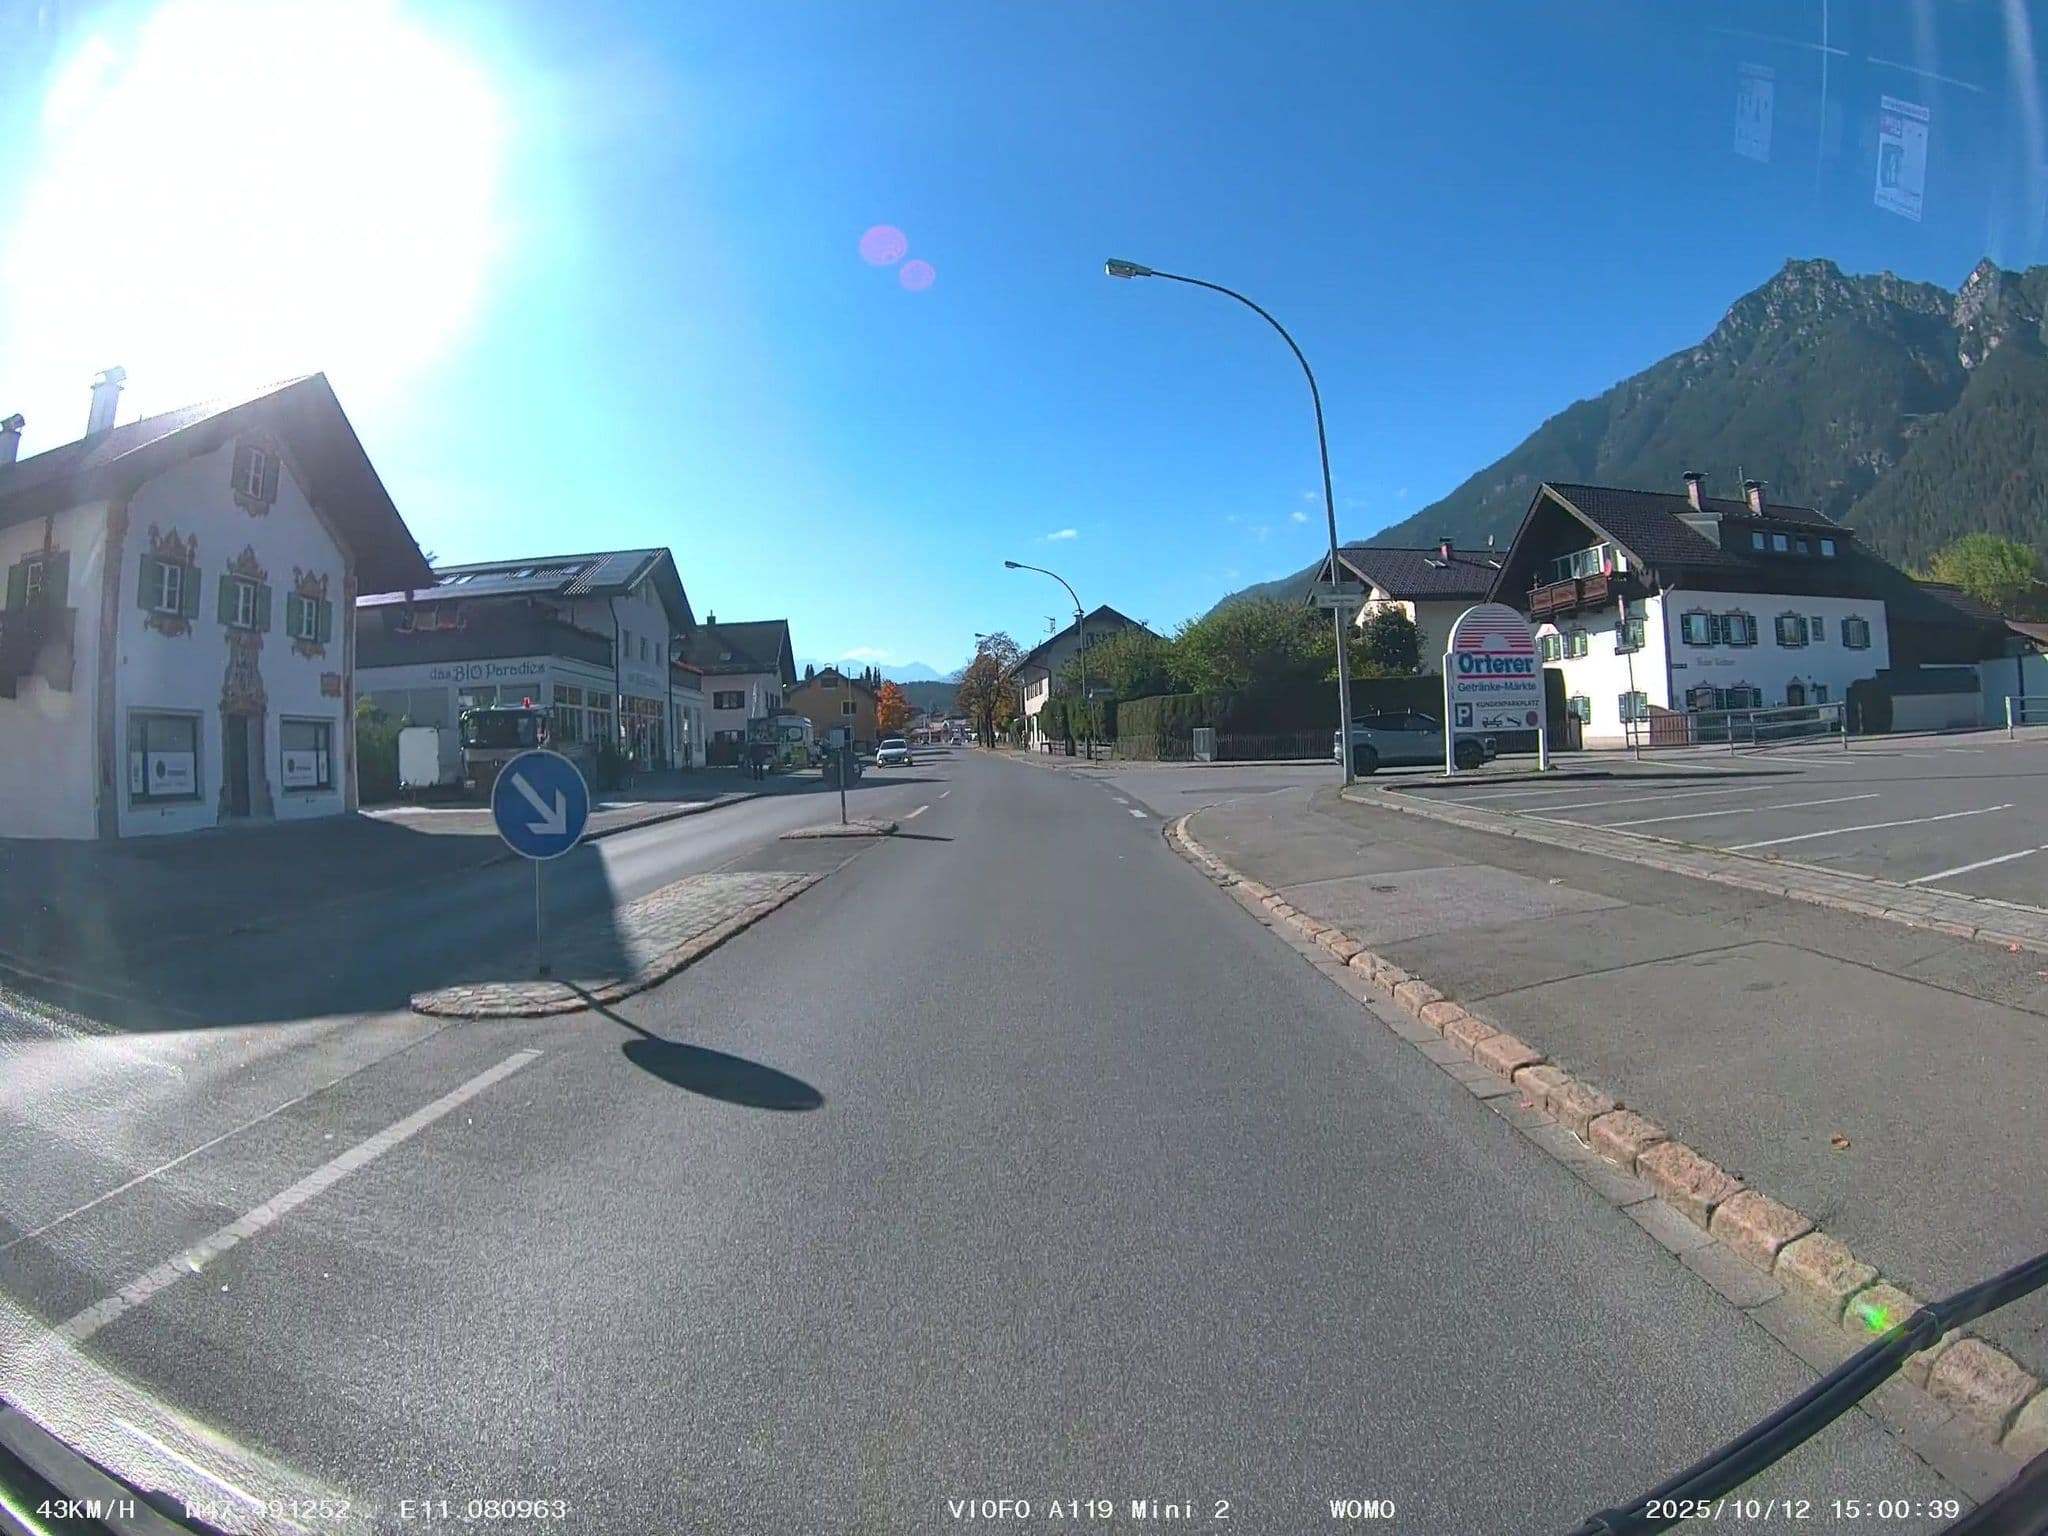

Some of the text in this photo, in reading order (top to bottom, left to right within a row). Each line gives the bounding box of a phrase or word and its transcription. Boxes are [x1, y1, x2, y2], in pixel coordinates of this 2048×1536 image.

[453, 664, 482, 682] BIO
[486, 661, 545, 679] Paradies
[1458, 652, 1534, 673] Orterer
[1458, 681, 1537, 693] Getränke-Märkte
[1457, 705, 1471, 725] P
